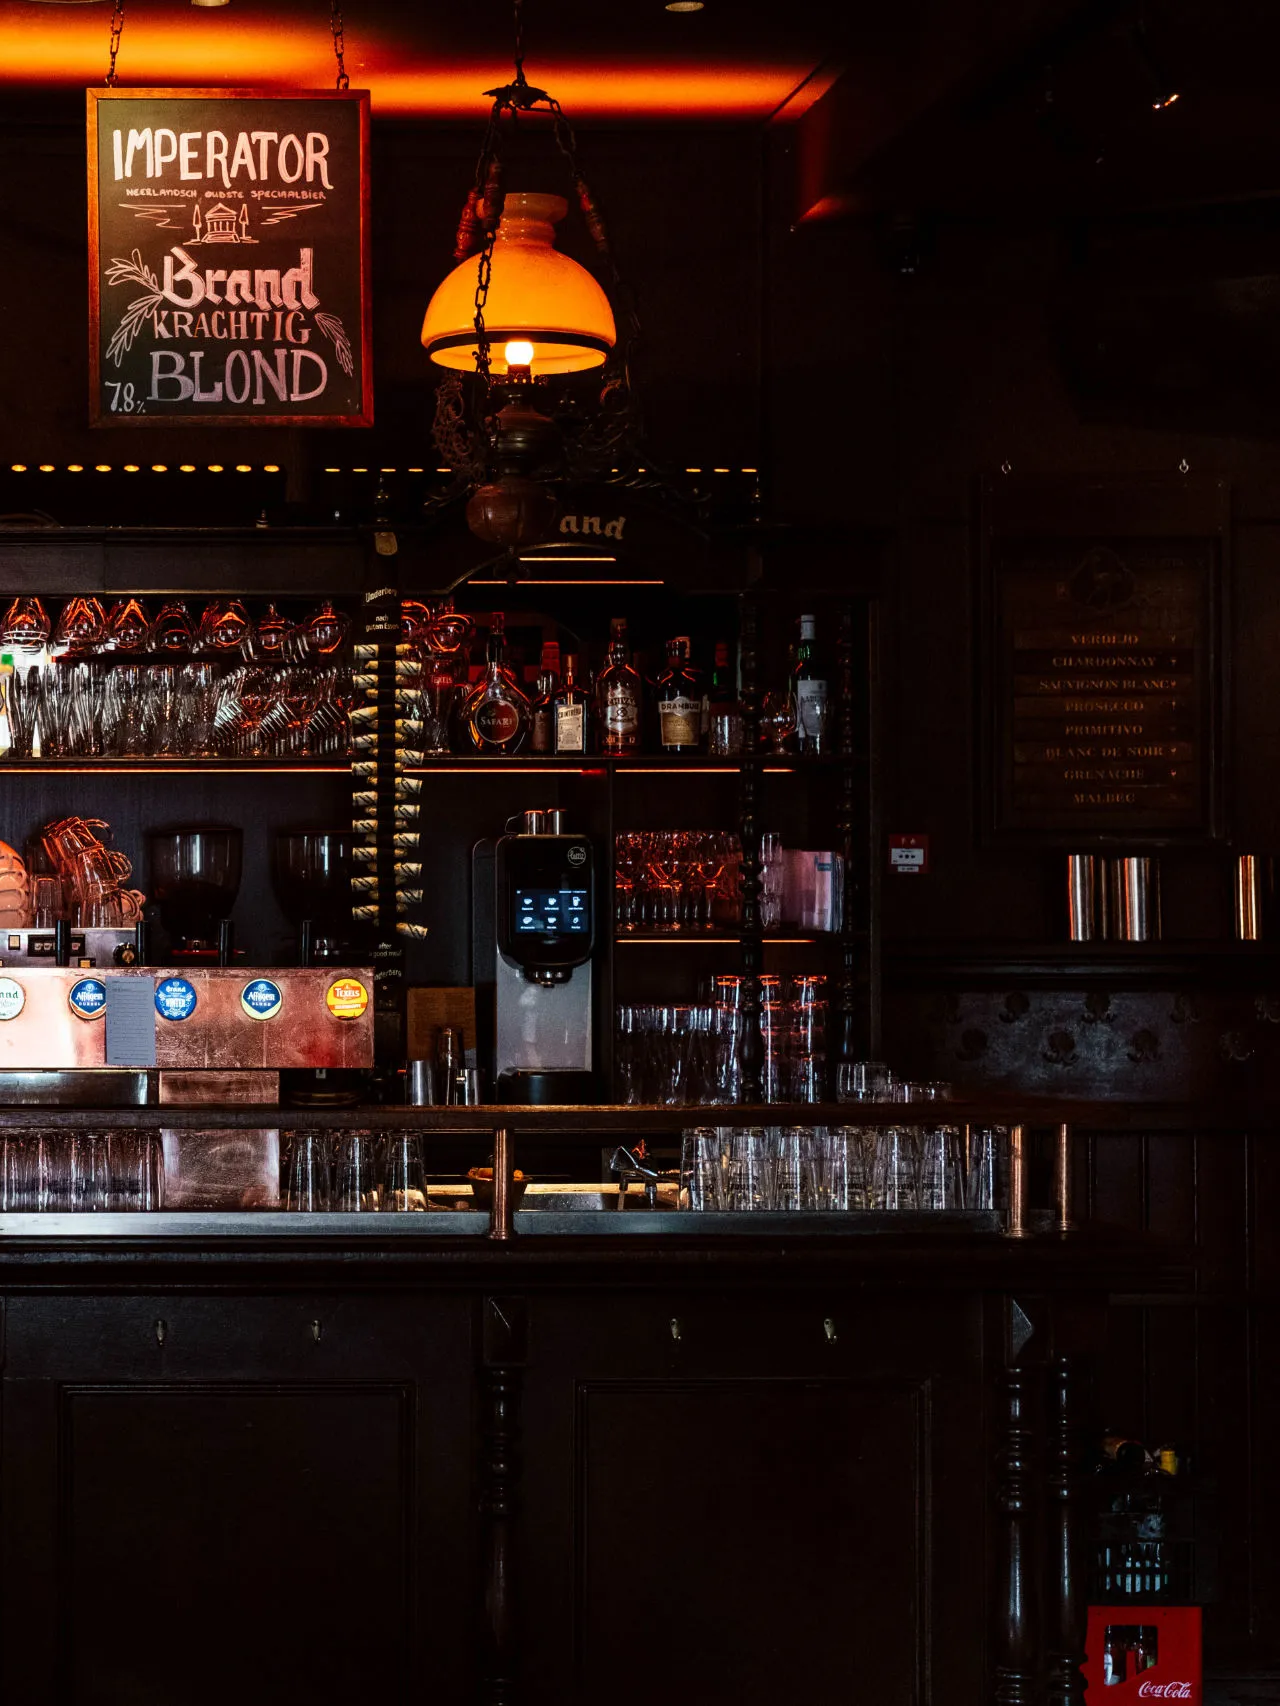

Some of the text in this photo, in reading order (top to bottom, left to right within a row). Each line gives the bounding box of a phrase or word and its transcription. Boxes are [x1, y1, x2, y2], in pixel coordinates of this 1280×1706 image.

[113, 127, 334, 189] IMPERATOR
[160, 246, 320, 312] Brand
[153, 310, 313, 345] KRACHTIG
[147, 348, 328, 405] BLOND
[1138, 1680, 1193, 1699] Coca-Cola
